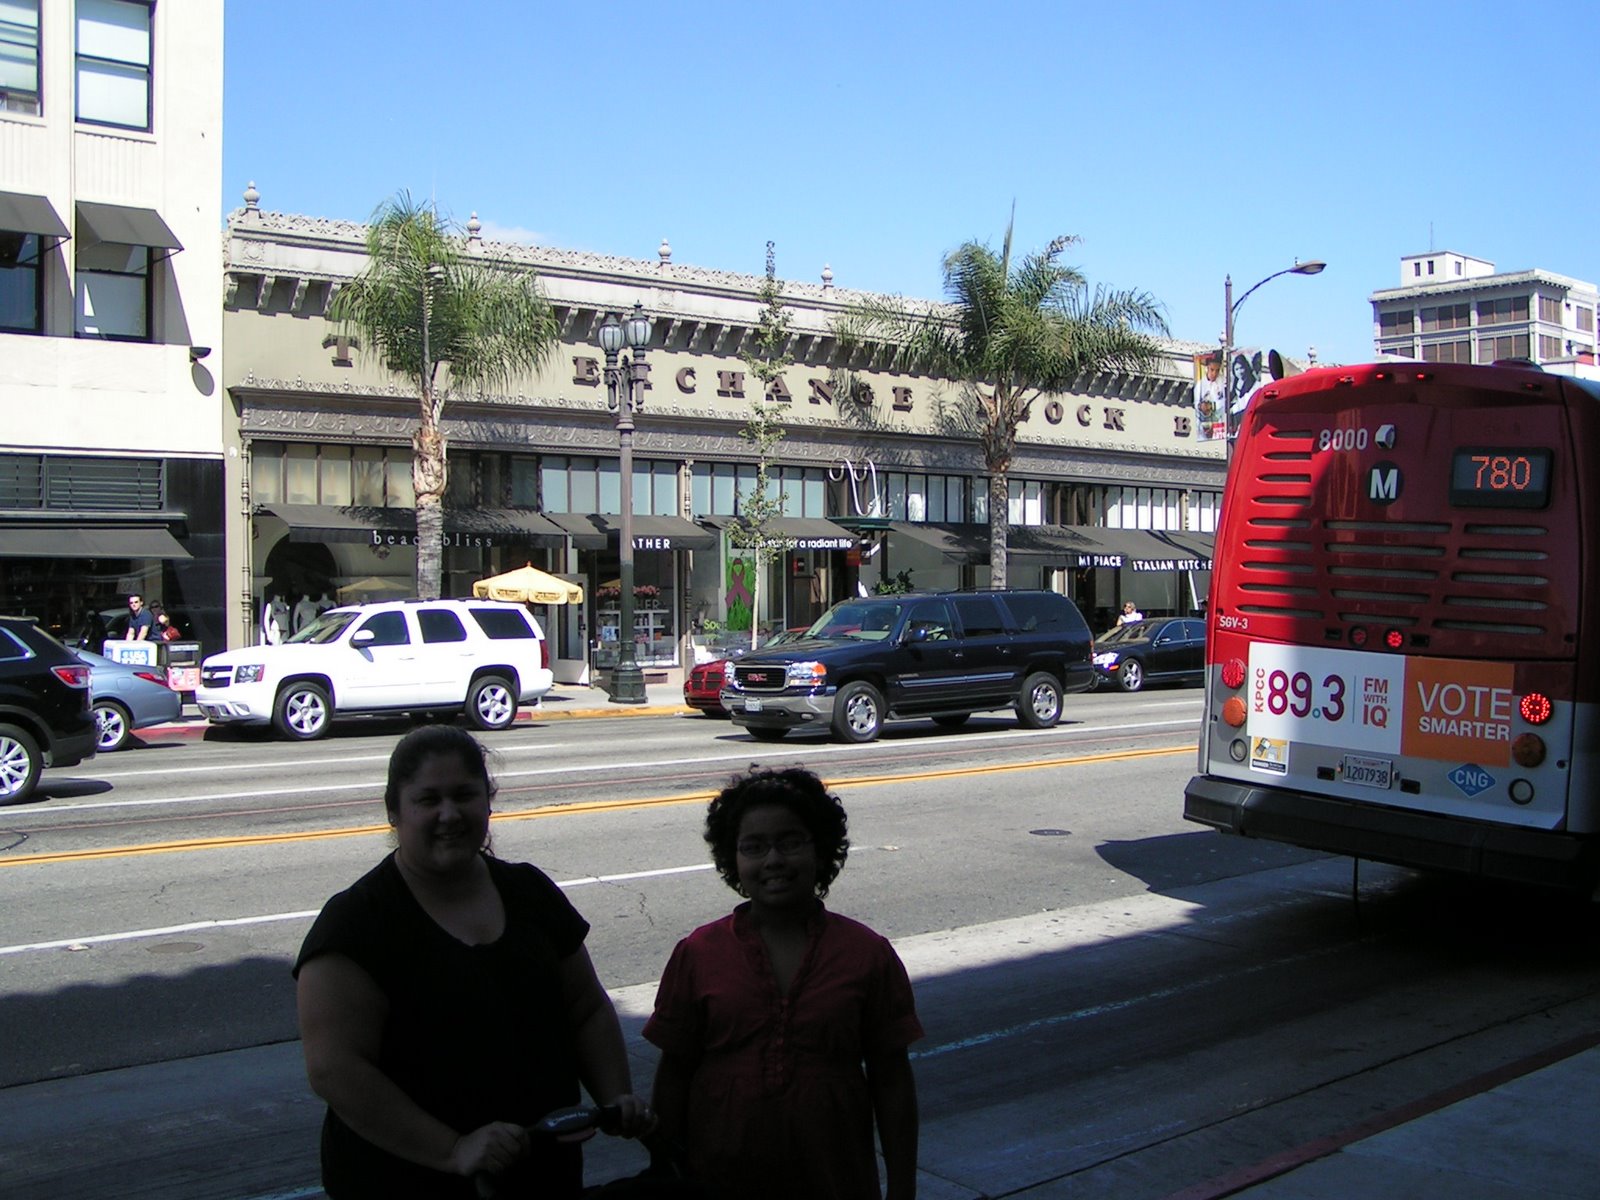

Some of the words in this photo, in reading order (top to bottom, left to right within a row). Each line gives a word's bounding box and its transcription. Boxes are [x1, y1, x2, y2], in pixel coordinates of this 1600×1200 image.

[572, 356, 914, 413] ECHANGE
[1318, 428, 1368, 451] 8000
[1471, 455, 1531, 490] 780
[1369, 468, 1398, 499] M
[373, 530, 421, 545] beac
[442, 533, 492, 547] bliss
[799, 540, 806, 548] a
[807, 538, 838, 548] radiant
[839, 538, 852, 548] life
[1078, 556, 1091, 566] MI
[1094, 556, 1122, 566] PIACE
[1132, 560, 1174, 571] ITALIAN
[1178, 560, 1213, 571] KITCHE
[1219, 615, 1248, 630] SGV-3
[1254, 668, 1265, 713] KPCC
[1267, 669, 1345, 722] 89.3
[1364, 677, 1388, 694] FM
[1363, 694, 1388, 704] WITH
[1417, 681, 1512, 720] VOTE
[1419, 716, 1510, 741] SMARTER
[1346, 765, 1389, 784] 1207938
[1455, 769, 1488, 788] CNG
